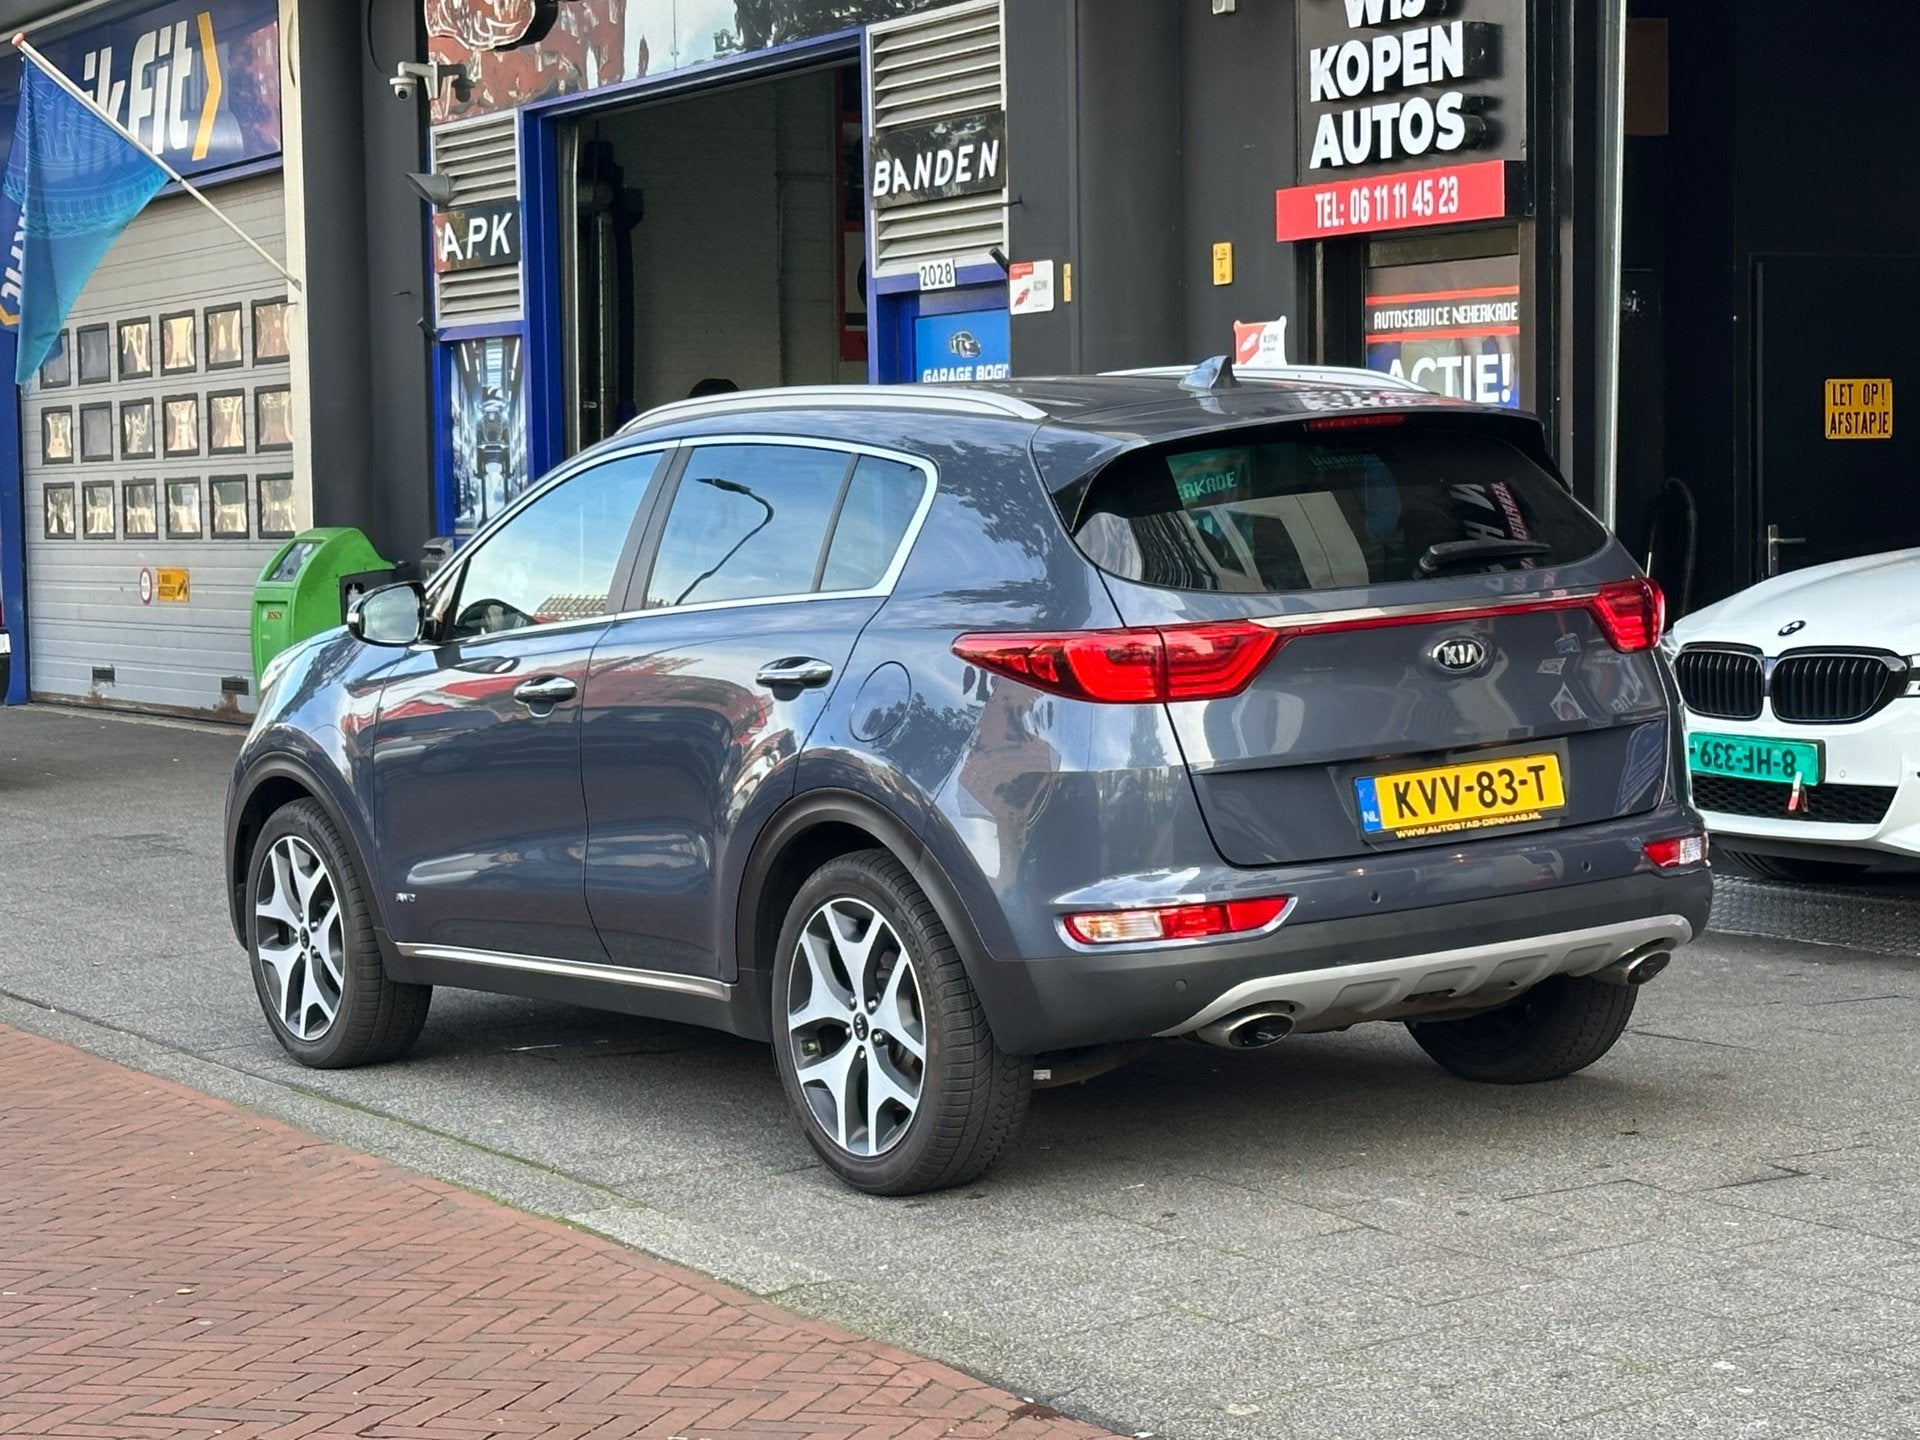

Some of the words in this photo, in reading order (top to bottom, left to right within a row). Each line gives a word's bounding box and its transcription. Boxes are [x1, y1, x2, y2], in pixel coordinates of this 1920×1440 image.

[1310, 20, 1464, 103] KOPEN
[1309, 92, 1466, 169] AUTOS
[873, 139, 999, 197] BANDEN
[1315, 191, 1344, 229] TEL:
[1350, 187, 1370, 225] 06
[1374, 184, 1389, 221] 11
[1393, 182, 1408, 219] 11
[1412, 179, 1433, 217] 45
[1438, 175, 1459, 214] 23
[441, 212, 512, 262] APK
[920, 263, 953, 287] 2028
[1374, 307, 1450, 330] AUTOSERVICE
[1452, 302, 1519, 325] NEHERKADE
[923, 366, 973, 383] GARAGE
[1832, 383, 1854, 406] LET
[1863, 383, 1885, 406] OP!
[1829, 411, 1889, 435] AFSTAPJE
[1442, 643, 1479, 666] KIA
[1393, 764, 1546, 819] KVV-83-T
[1362, 810, 1380, 823] NL
